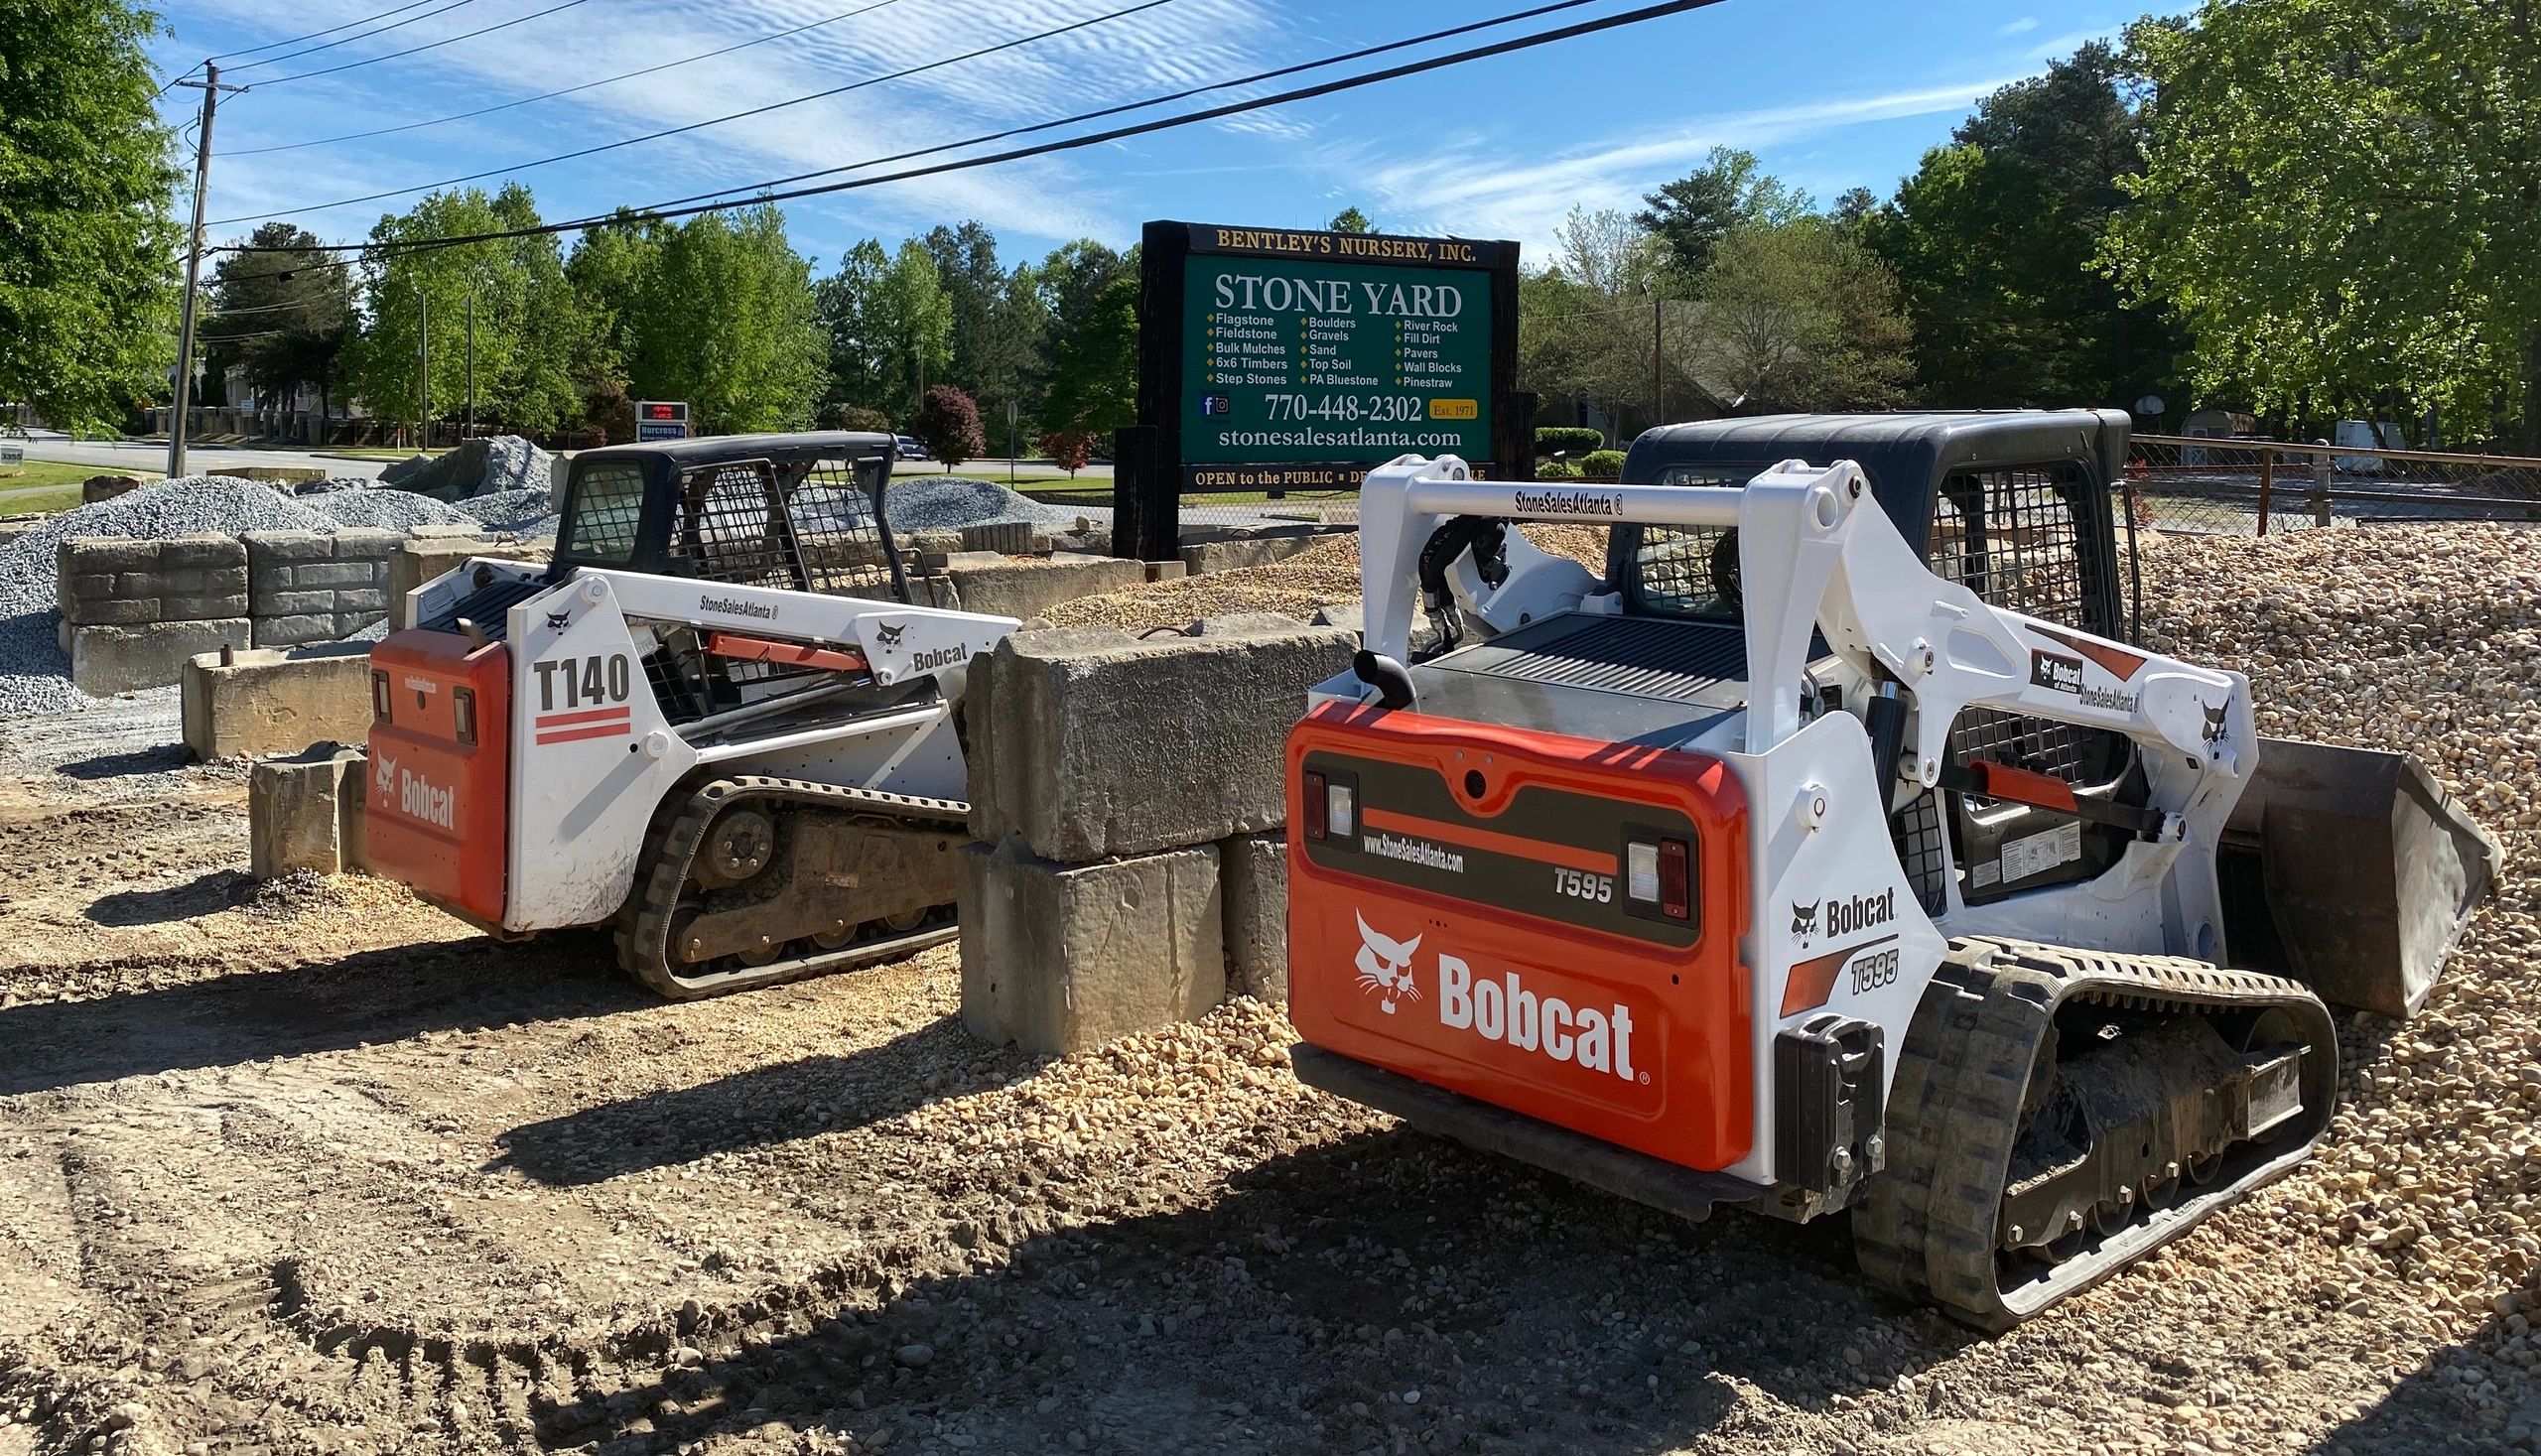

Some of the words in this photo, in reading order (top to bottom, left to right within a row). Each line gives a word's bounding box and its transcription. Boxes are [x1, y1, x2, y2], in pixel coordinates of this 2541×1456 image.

[1217, 229, 1331, 254] BENTLEY'S
[1339, 237, 1433, 262] NURSERY,
[1438, 243, 1476, 262] INC.
[1215, 273, 1353, 314] STONE
[1361, 282, 1462, 318] YARD
[1216, 313, 1274, 328] Flagstone
[1309, 317, 1356, 329] Boulders
[1404, 320, 1430, 331] River
[1432, 321, 1458, 332] Rock
[1216, 327, 1277, 339] Fieldstone
[1309, 329, 1349, 340] Gravels
[1404, 332, 1419, 343] Fill
[1421, 332, 1440, 344] Dirt
[1216, 341, 1240, 353] Bulk
[1243, 342, 1285, 354] Mulches
[1309, 343, 1337, 355] Sand
[1404, 347, 1438, 358] Pavers
[1216, 356, 1238, 368] 6x6
[1241, 357, 1288, 369] Timbers
[1309, 358, 1329, 372] Top
[1331, 358, 1352, 370] Soil
[1404, 361, 1425, 373] Wall
[1428, 362, 1462, 373] Blocks
[1216, 372, 1243, 385] Step
[1247, 373, 1287, 385] Stones
[1309, 373, 1324, 384] PA
[1326, 374, 1379, 385] Bluestone
[1404, 376, 1453, 388] Pinestraw
[1265, 394, 1422, 422] 770-448-2302
[1434, 405, 1452, 416] Est.
[1455, 405, 1474, 416] 1971
[641, 426, 677, 435] Norcross
[1219, 426, 1462, 447] stonesalesatlanta.com
[1195, 471, 1236, 485] OPEN
[1240, 471, 1254, 485] to
[1258, 470, 1280, 484] the
[1283, 471, 1333, 484] PUBLIC
[1515, 490, 1613, 515] StoneSalesAtlanta
[700, 595, 771, 619] StoneSalesAtlanta
[913, 642, 967, 673] Bobcat
[2053, 662, 2081, 685] Bobcat
[533, 653, 630, 711] T140
[2079, 683, 2133, 713] StoneSalesAtlanta
[401, 768, 455, 831] Bobcat
[1363, 833, 1464, 873] www.StoneSalesAtlanta.com
[1554, 866, 1614, 904] T595
[1827, 886, 1895, 939] Bobcat
[1852, 948, 1900, 995] T595
[1438, 954, 1634, 1083] Bobcat
